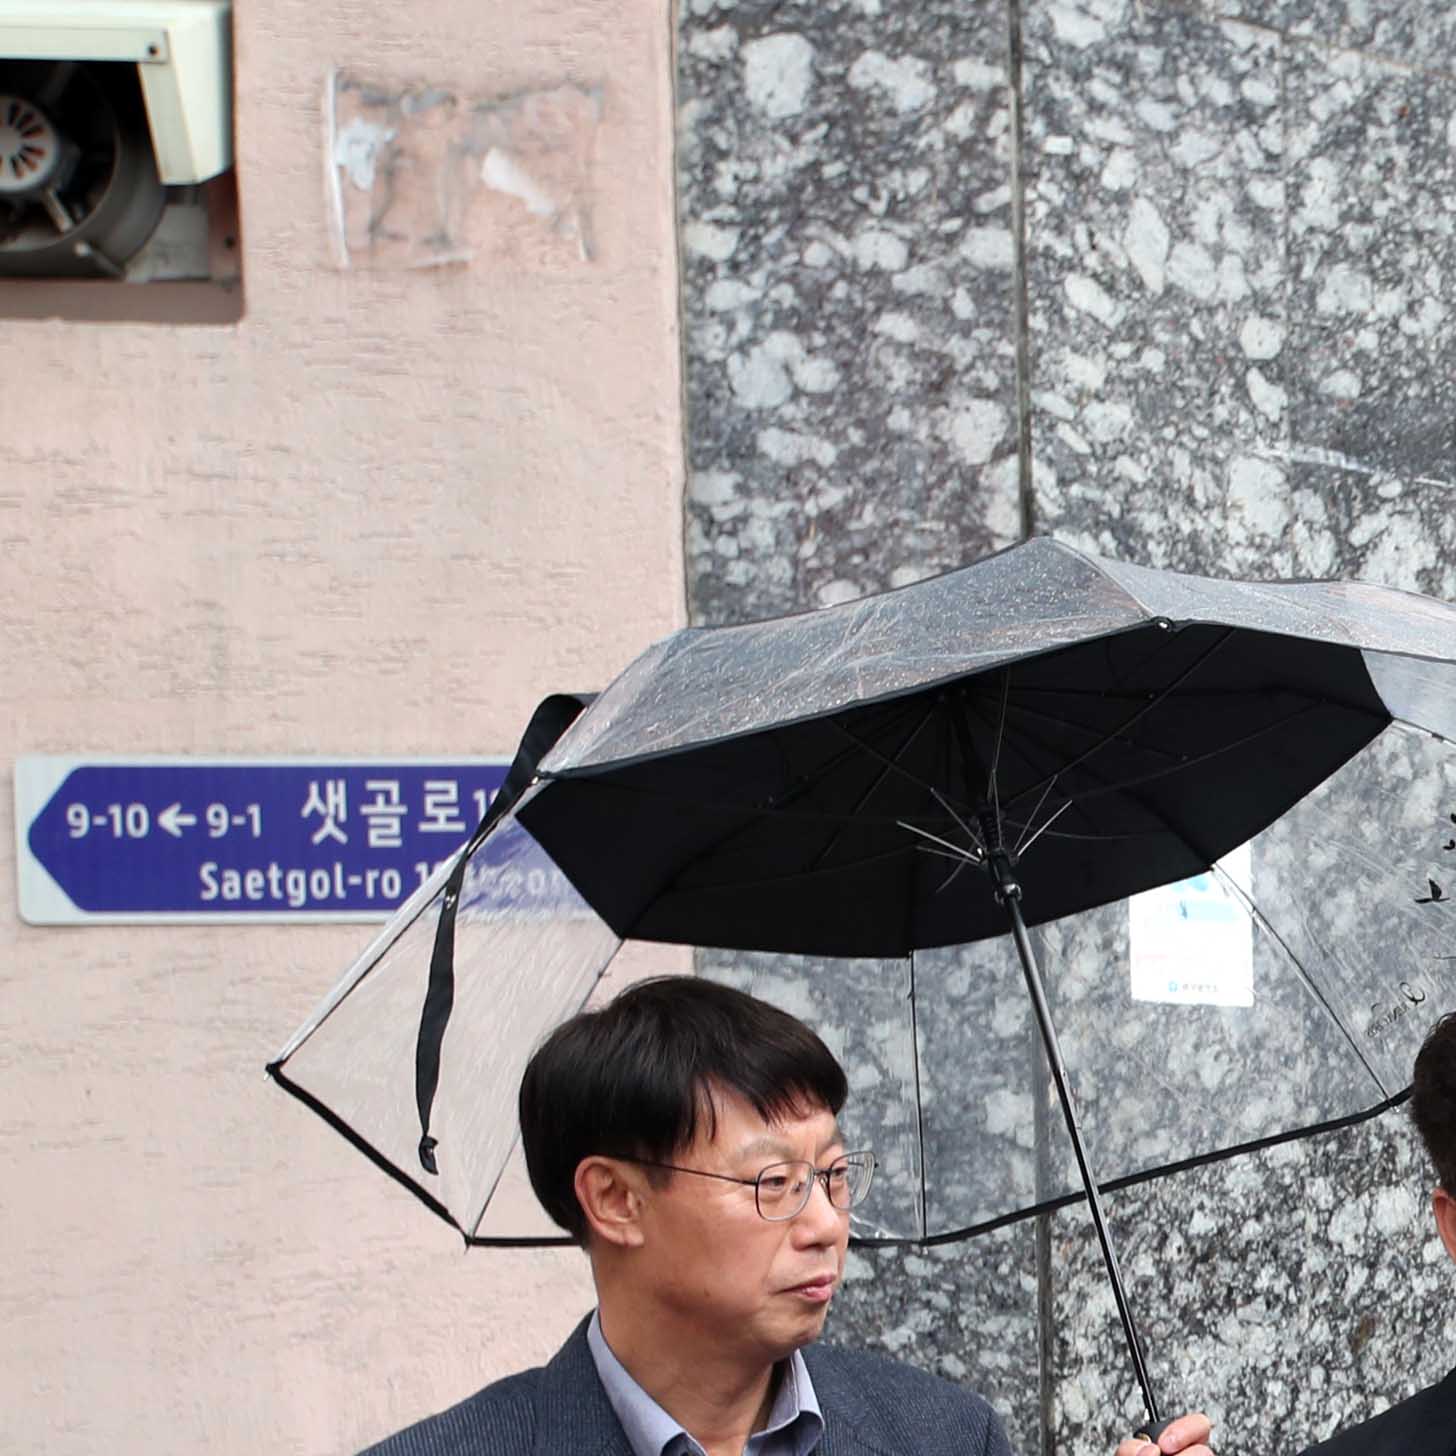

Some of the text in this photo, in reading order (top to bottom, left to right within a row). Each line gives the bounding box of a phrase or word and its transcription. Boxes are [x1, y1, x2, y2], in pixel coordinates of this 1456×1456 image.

[66, 803, 150, 839] 9-10
[206, 803, 262, 839] 9-1
[200, 861, 402, 908] Saetgol-ro
